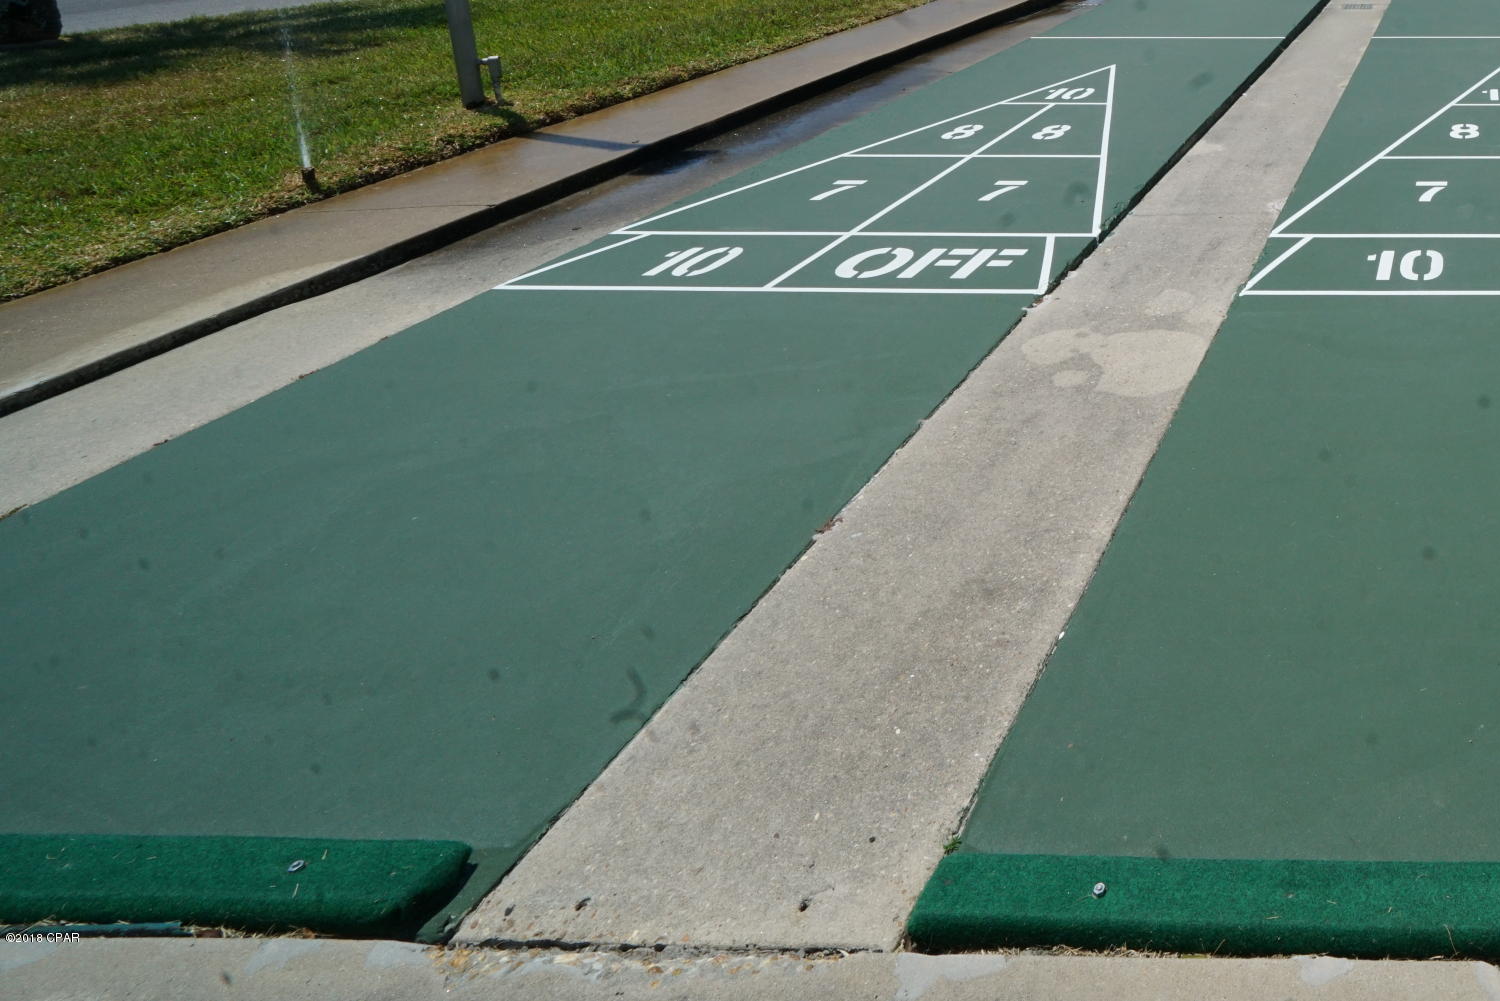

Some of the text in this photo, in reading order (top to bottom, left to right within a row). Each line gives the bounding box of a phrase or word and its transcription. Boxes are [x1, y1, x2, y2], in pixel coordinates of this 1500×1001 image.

[1045, 88, 1095, 99] 10
[941, 124, 983, 140] 8
[1032, 124, 1071, 140] 8
[1449, 123, 1480, 139] 8
[810, 180, 868, 200] 7
[978, 180, 1029, 201] 7
[1415, 180, 1448, 202] 7
[642, 246, 744, 277] 10
[835, 247, 1029, 279] OFF
[1366, 249, 1444, 281] 10
